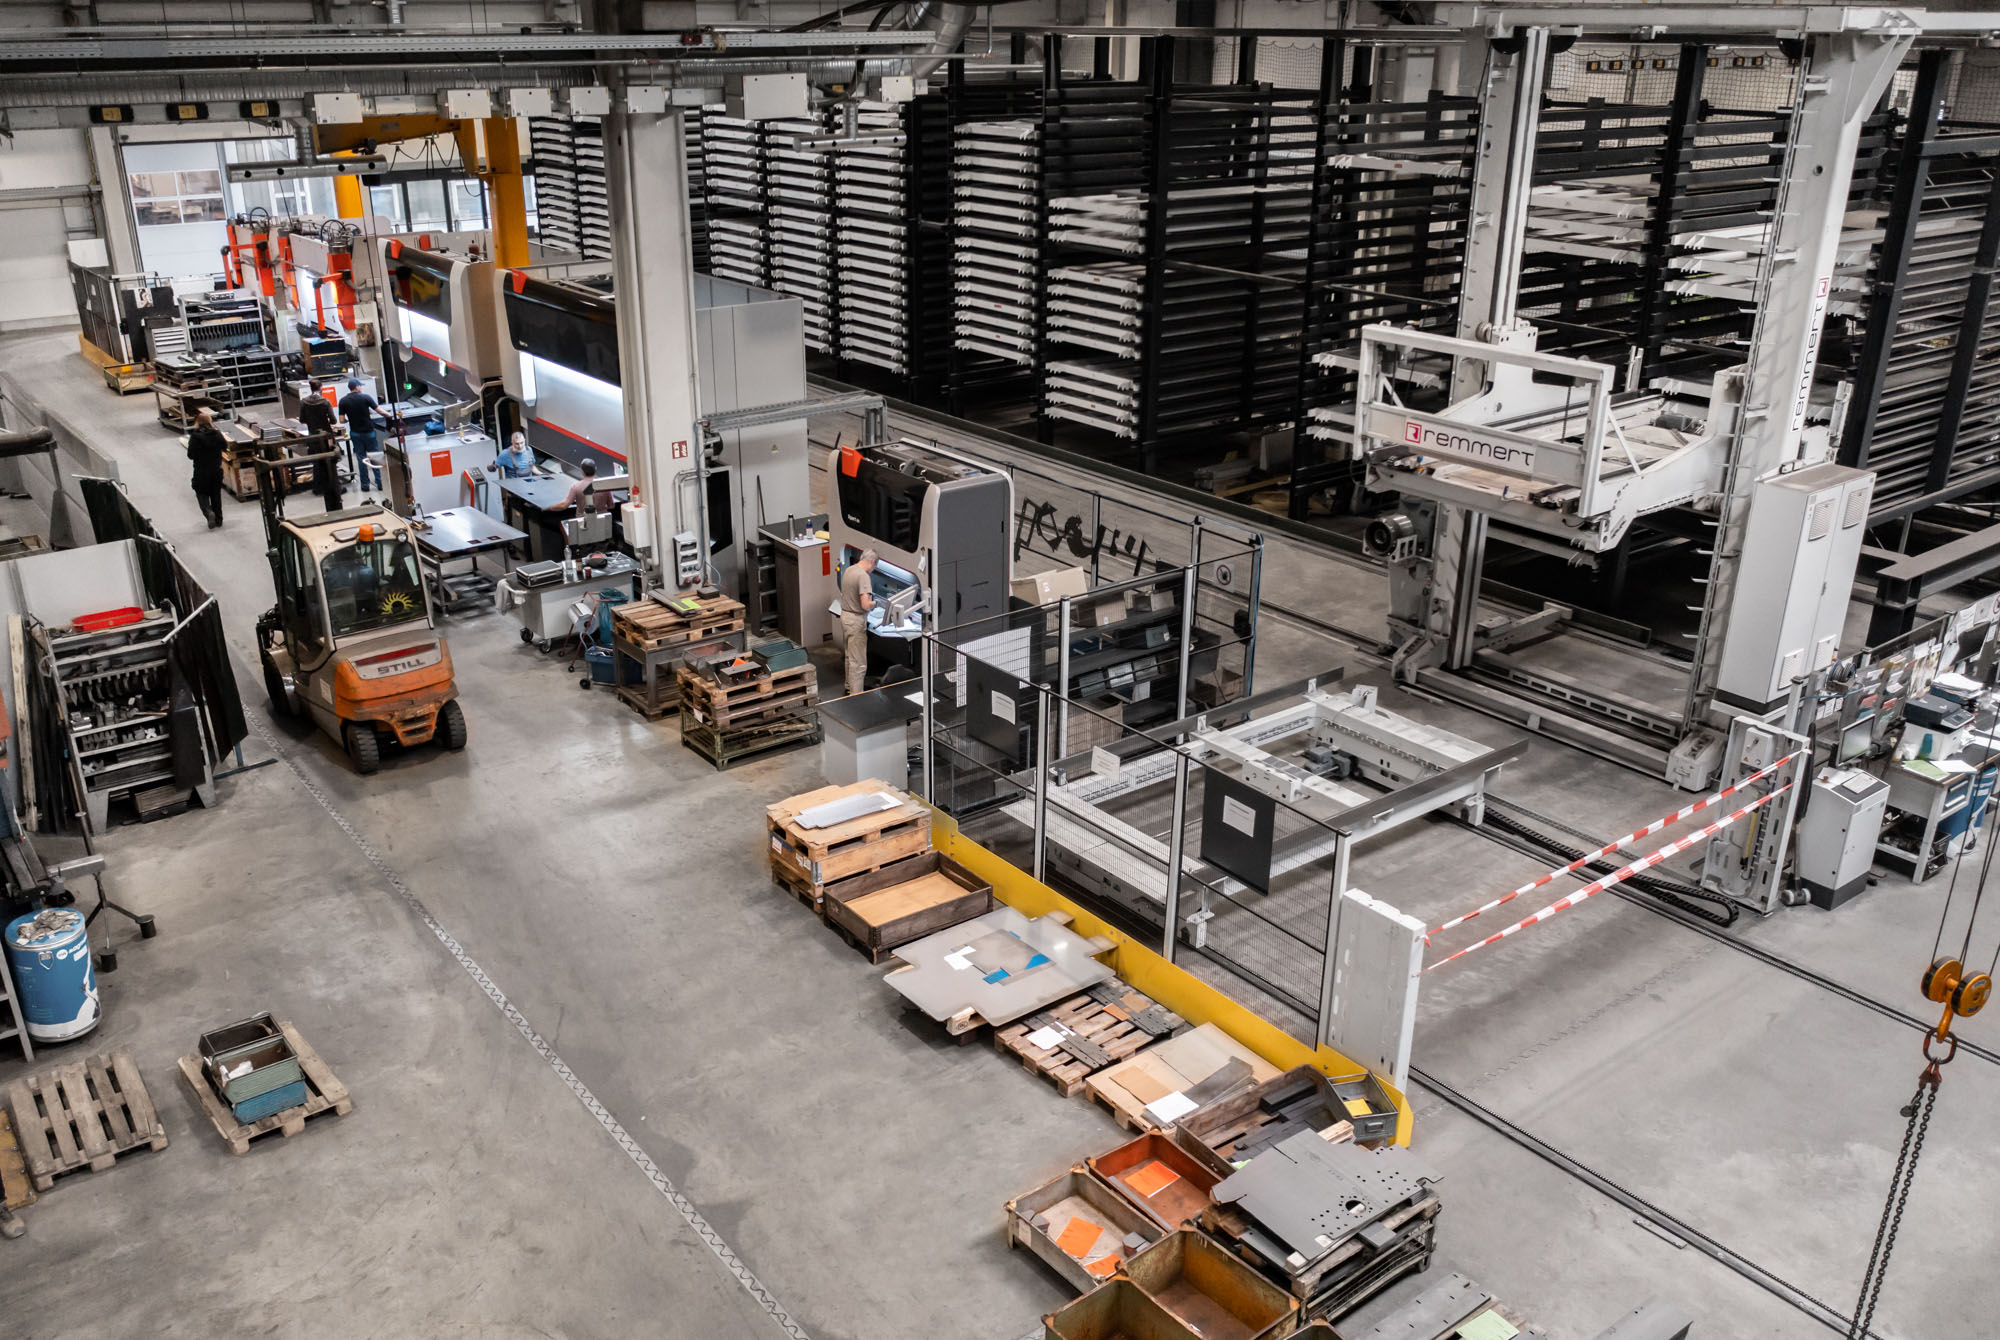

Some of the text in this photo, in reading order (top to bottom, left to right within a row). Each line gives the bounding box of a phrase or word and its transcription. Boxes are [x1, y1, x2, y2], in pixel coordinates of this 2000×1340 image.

[1792, 303, 1823, 431] remmert
[1424, 429, 1534, 466] remmert
[377, 658, 426, 674] STILL
